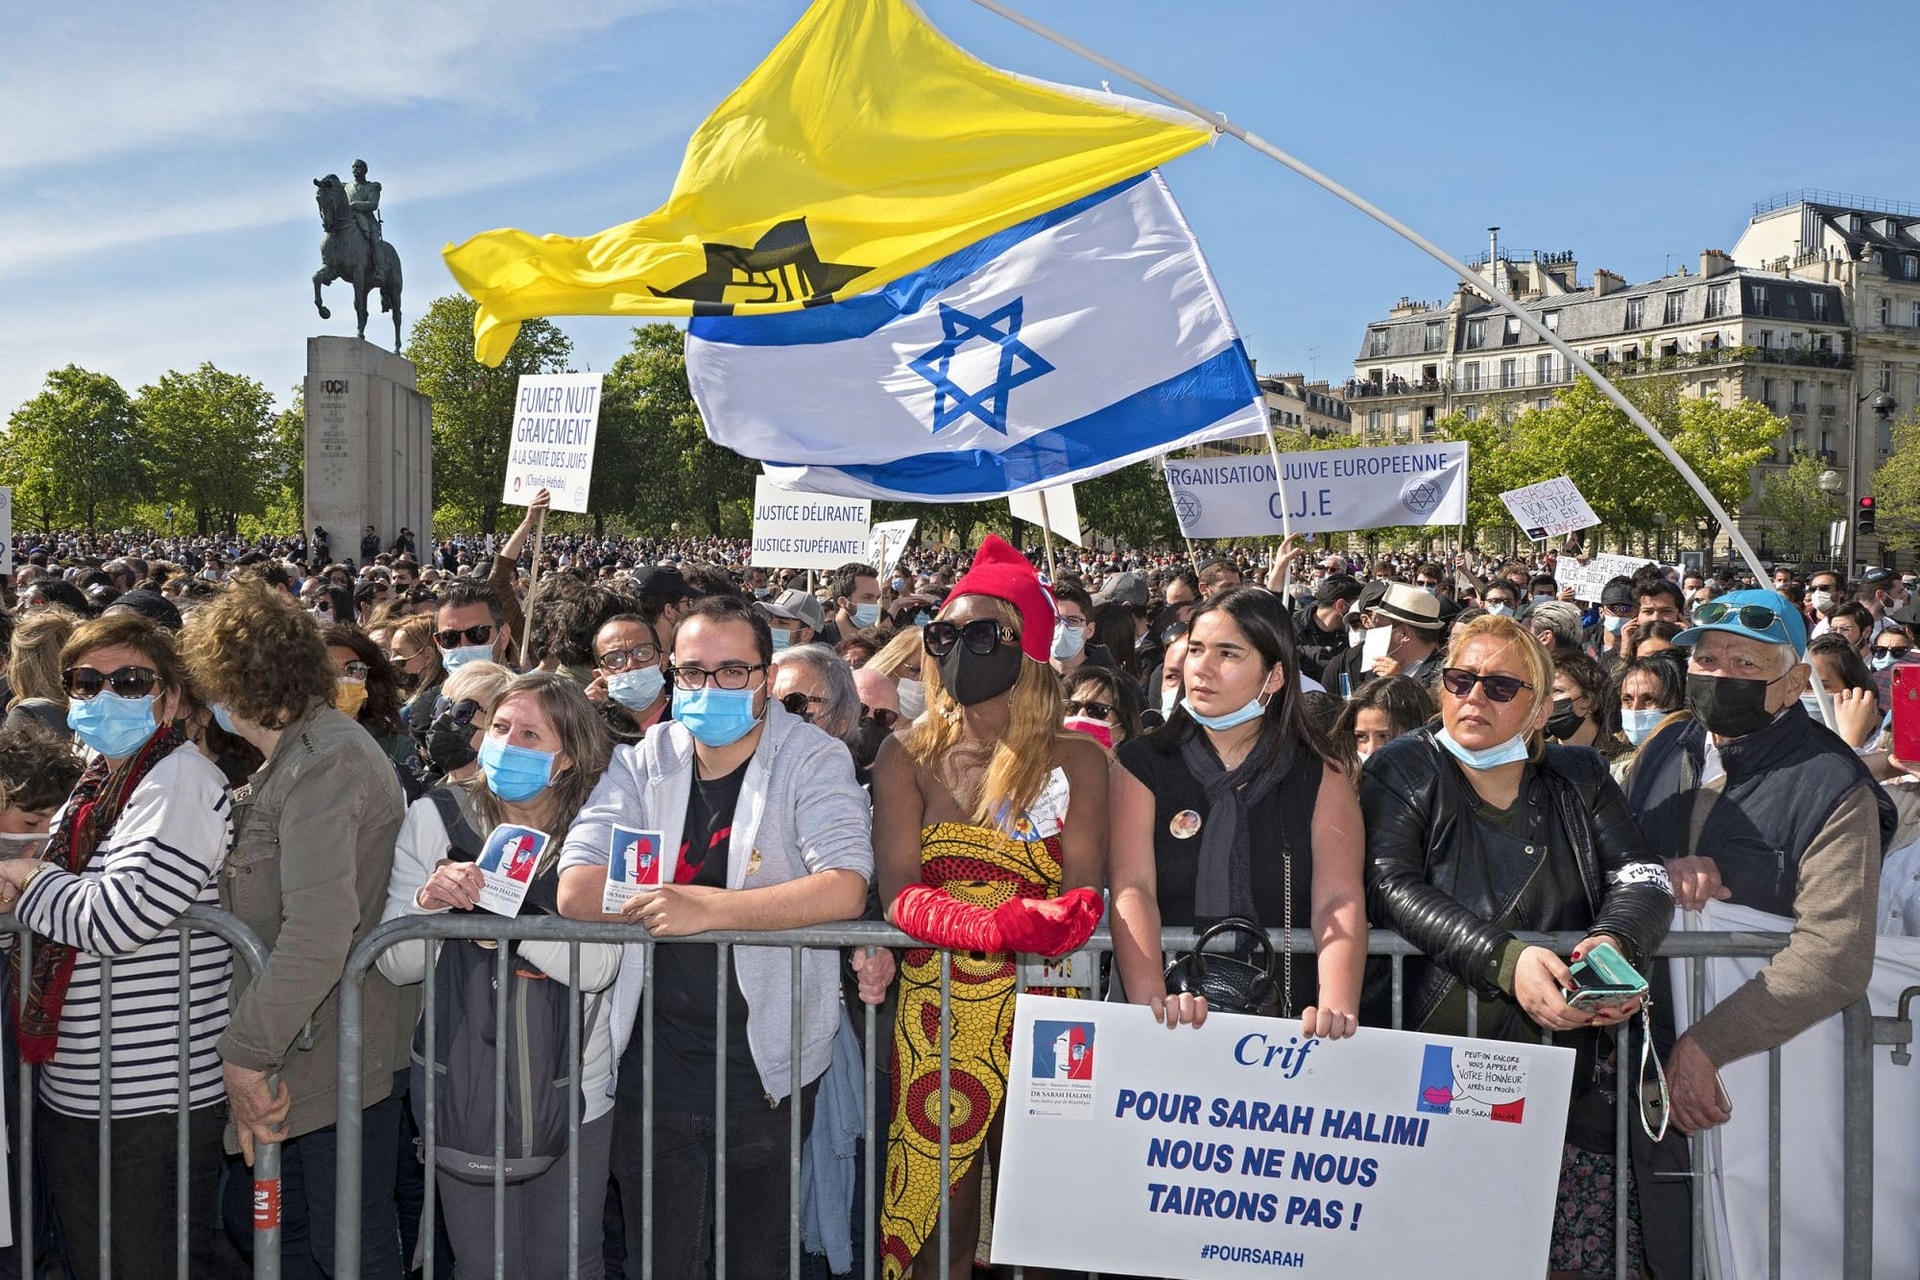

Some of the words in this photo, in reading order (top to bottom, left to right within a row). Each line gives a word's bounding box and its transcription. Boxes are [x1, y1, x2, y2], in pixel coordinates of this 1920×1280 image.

[320, 379, 349, 394] FOCH
[520, 387, 563, 413] FUMER
[564, 386, 597, 414] NUIT
[517, 417, 591, 445] GRAVEMENT
[518, 449, 526, 465] LA
[527, 447, 550, 467] SANTÉ
[550, 451, 565, 468] DES
[565, 452, 587, 469] JUIFS
[1283, 461, 1329, 480] JUIVE
[1334, 453, 1448, 477] EUROPEENNE
[1506, 481, 1576, 508] ASSASSIN
[756, 505, 799, 521] JUSTICE
[802, 502, 867, 525] DÉLIRANTE,
[1521, 500, 1549, 519] NON
[1532, 512, 1556, 527] PAYS
[1560, 506, 1578, 519] EN
[753, 538, 792, 553] JUSTICE
[793, 537, 858, 554] STUPÉFIANTE
[860, 541, 865, 554] !
[1044, 958, 1072, 977] MI
[1234, 1033, 1320, 1079] Crif
[1468, 1060, 1484, 1068] VOUS
[1486, 1062, 1518, 1071] APPELER
[1493, 1054, 1520, 1063] ENCORE
[1115, 1089, 1201, 1125] POUR
[1208, 1098, 1314, 1136] SARAH
[1320, 1108, 1430, 1148] HALIMI
[1455, 1106, 1470, 1115] POUR
[1147, 1138, 1234, 1174] NOUS
[1241, 1147, 1285, 1178] NE
[1290, 1152, 1378, 1188] NOUS
[1148, 1183, 1278, 1223] TAIRONS
[1285, 1196, 1343, 1230] PAS
[1350, 1202, 1363, 1232] !
[1200, 1244, 1304, 1268] #POURSARAH
